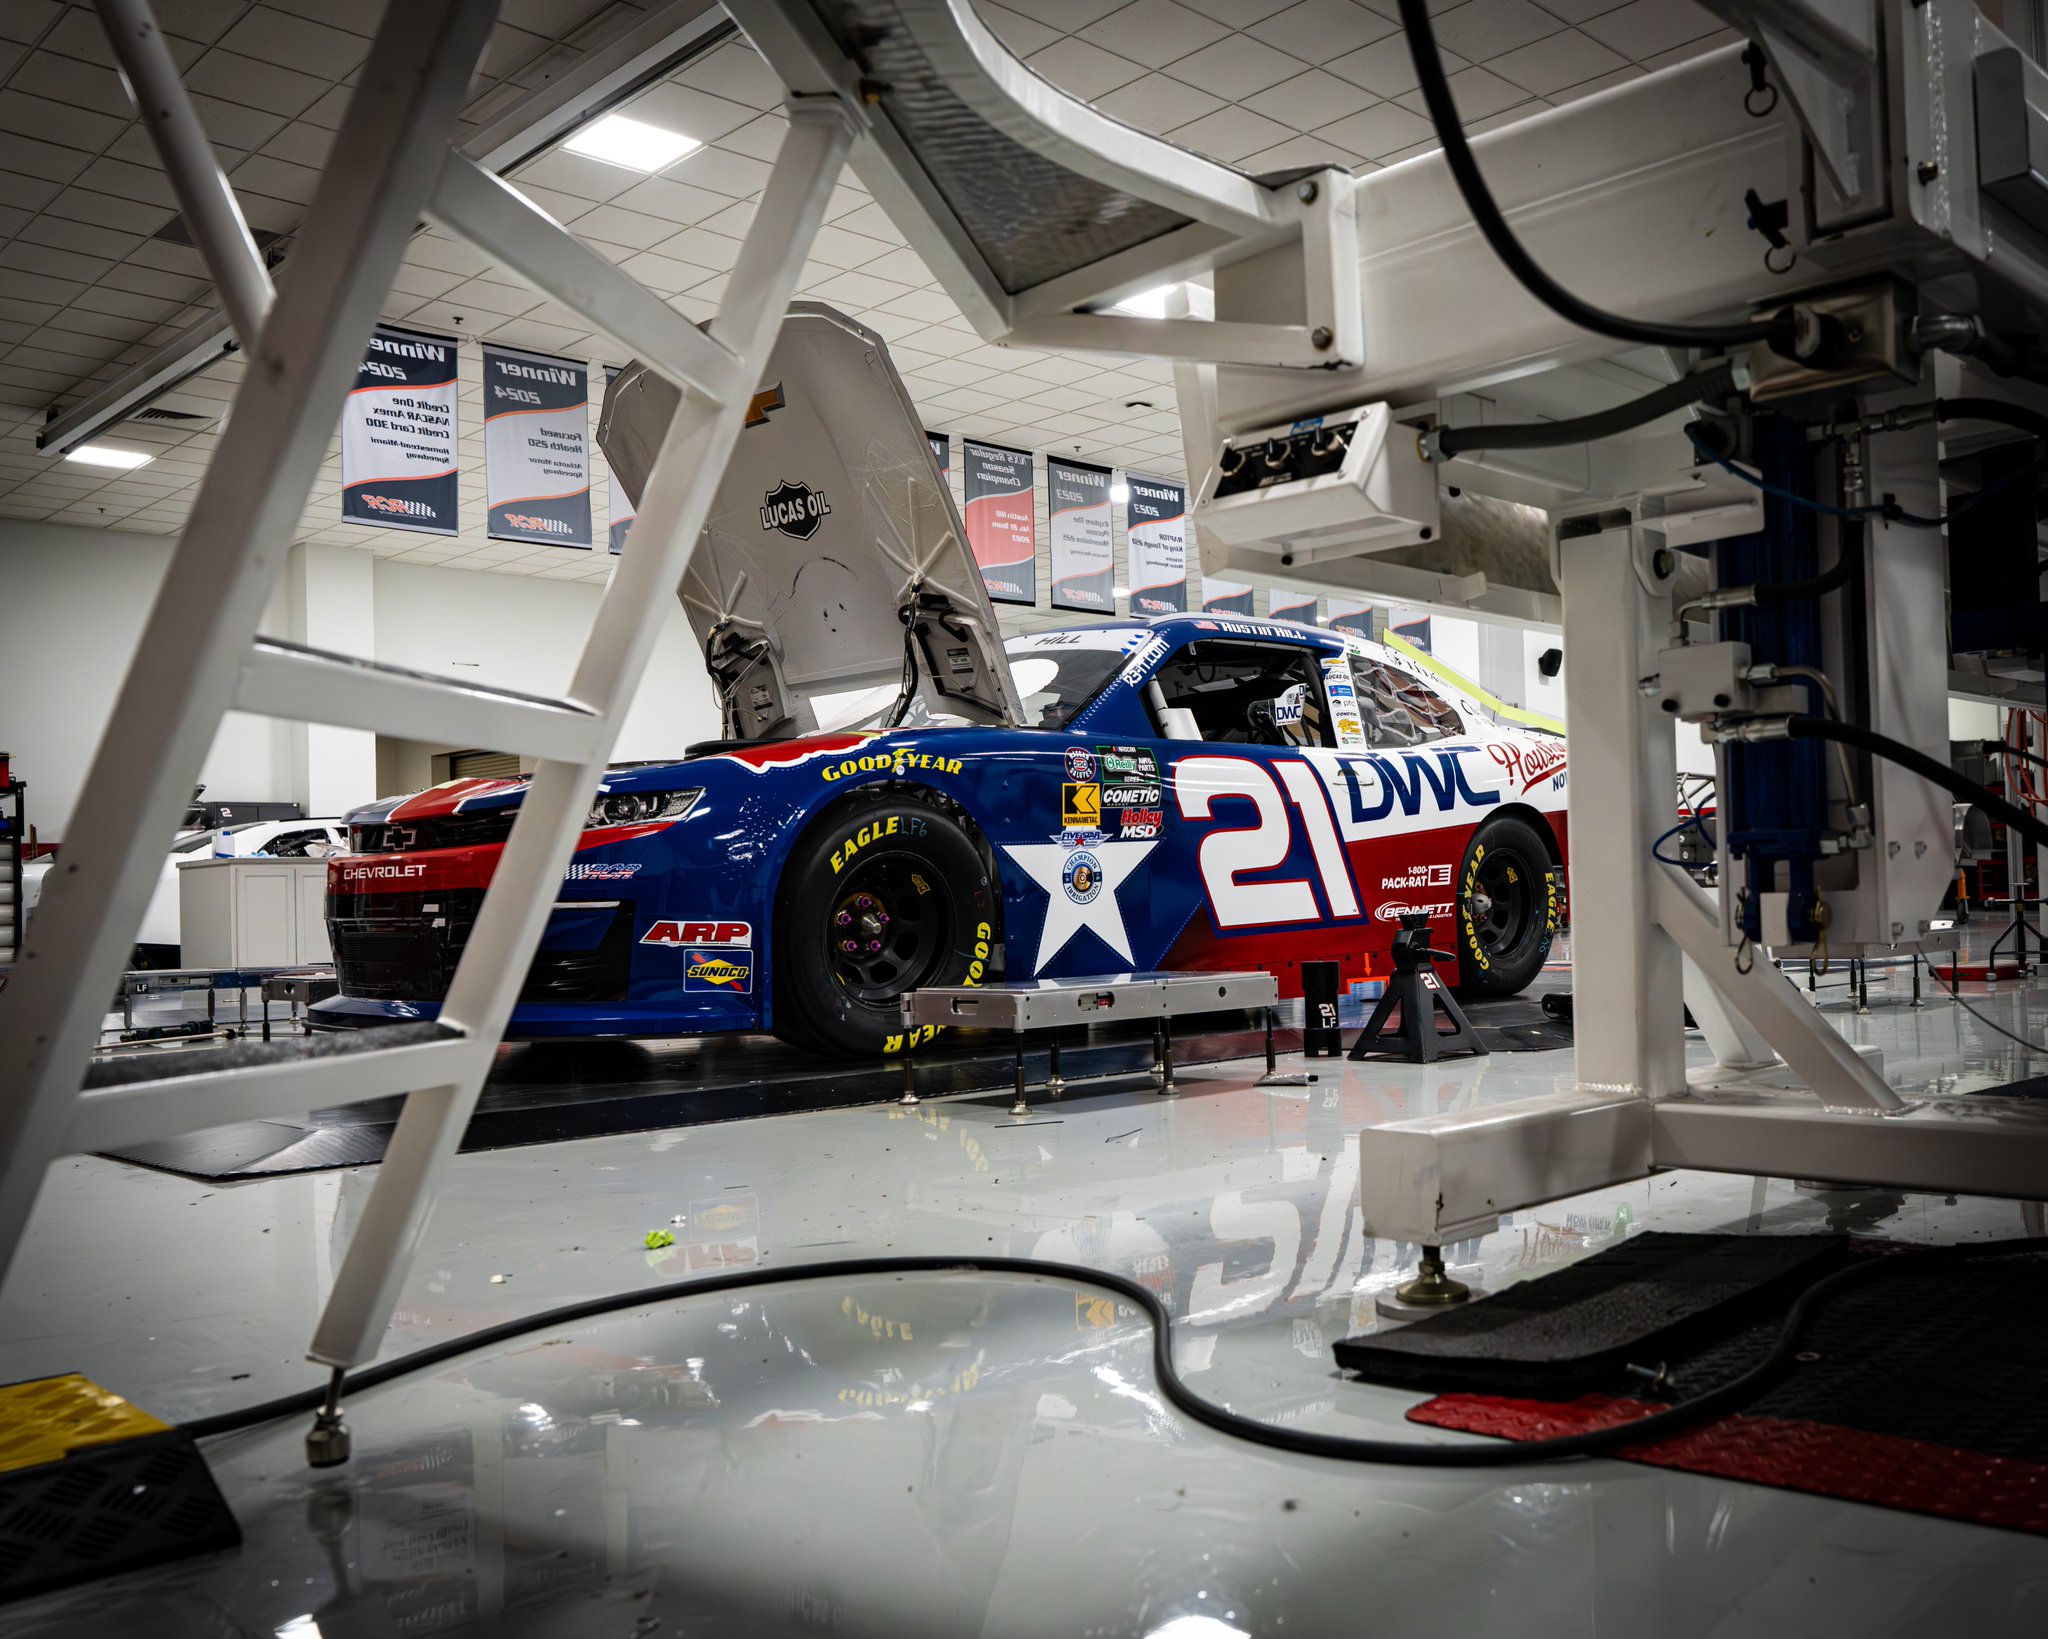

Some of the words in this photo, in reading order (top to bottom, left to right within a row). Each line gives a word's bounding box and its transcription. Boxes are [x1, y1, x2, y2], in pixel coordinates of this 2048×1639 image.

[760, 498, 806, 529] LUCAS
[807, 492, 831, 517] OIL
[1219, 622, 1273, 637] AUSTIN
[1272, 626, 1307, 640] HILL
[1035, 635, 1082, 646] HILL
[1276, 705, 1301, 720] DWC
[1138, 764, 1155, 772] PARTS
[1335, 746, 1500, 824] DWC
[1552, 771, 1568, 792] NO
[1103, 788, 1160, 803] COMETIC
[1064, 816, 1098, 824] KENNAMETAL
[1121, 808, 1163, 828] Holley
[900, 817, 928, 836] LF6
[1120, 825, 1157, 838] MSD
[1062, 832, 1080, 840] FIVE
[1082, 831, 1100, 839] STAR
[1173, 755, 1362, 930] 21
[830, 815, 900, 875] EAGLE
[1066, 853, 1097, 870] CHAMPION
[343, 864, 427, 880] CHEVROLET
[1066, 883, 1099, 902] IRRIGATION
[1383, 903, 1454, 918] BENNETT
[1545, 872, 1557, 933] EAGLE
[643, 922, 750, 943] ARP
[688, 966, 749, 979] SUNOCO
[1420, 972, 1440, 989] 21
[136, 984, 147, 992] LF
[1318, 1003, 1336, 1017] 21
[1322, 1017, 1336, 1029] LF
